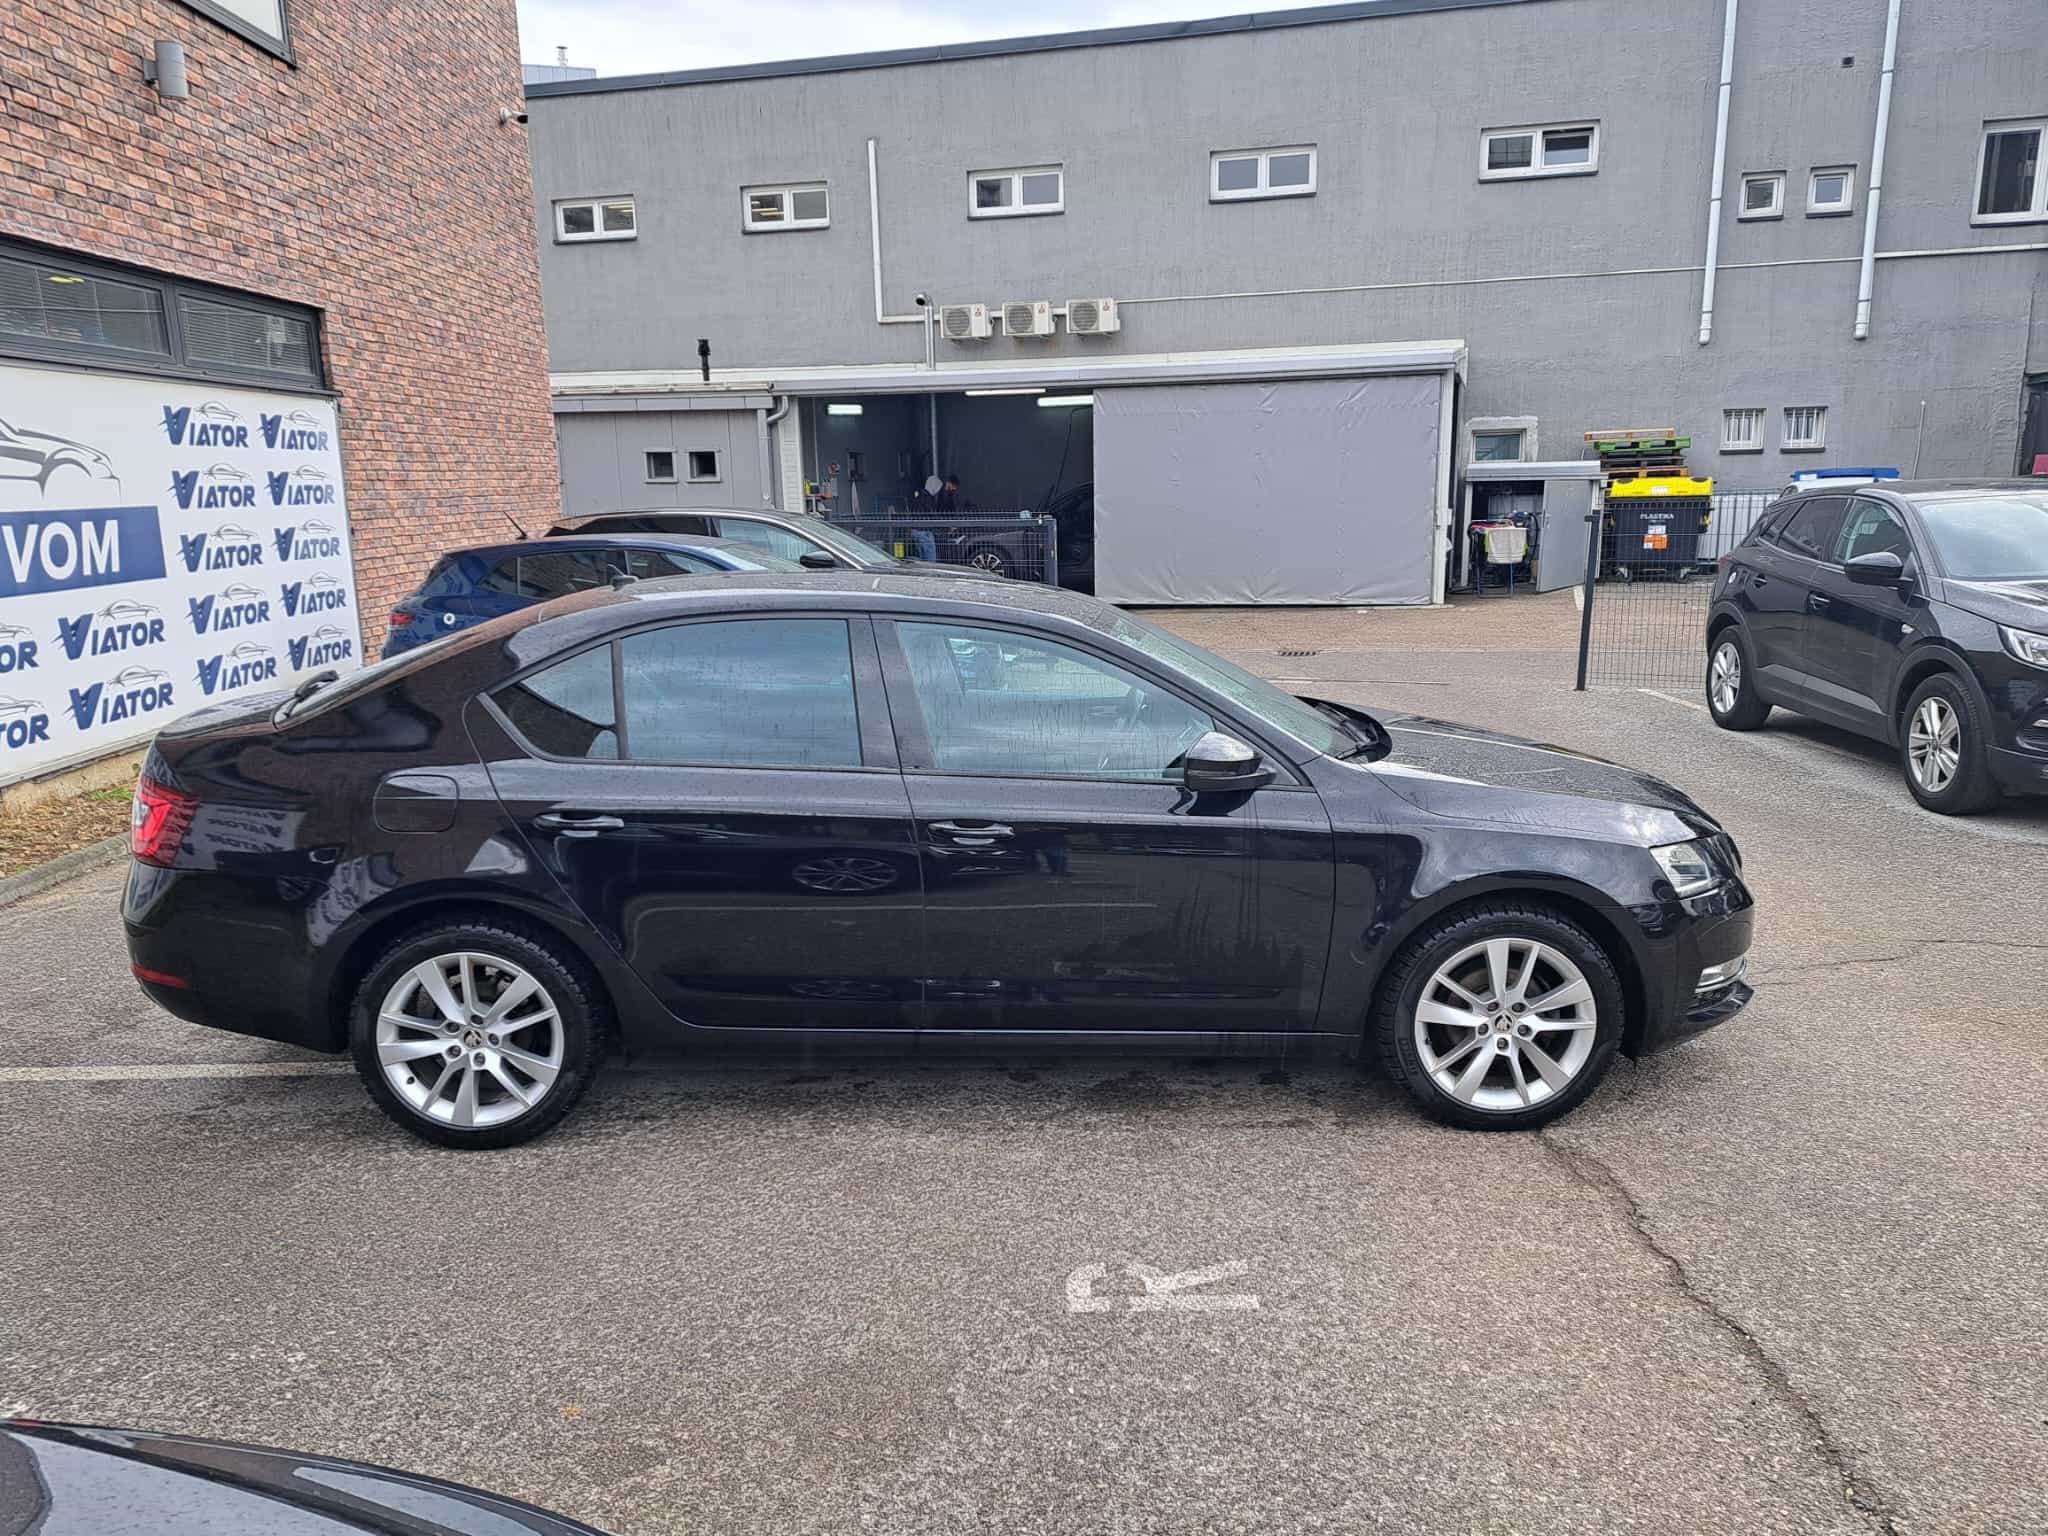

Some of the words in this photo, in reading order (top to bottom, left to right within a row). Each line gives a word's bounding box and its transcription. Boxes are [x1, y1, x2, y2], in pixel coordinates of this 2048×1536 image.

[163, 405, 249, 448] VIATOR
[260, 416, 328, 453] VIATOR
[171, 470, 256, 511] VIATOR
[266, 471, 336, 508] VIATOR
[1, 519, 121, 584] VOM
[180, 533, 262, 575] VIATOR
[274, 528, 342, 561] VIATOR
[188, 595, 271, 636] VIATOR
[279, 582, 348, 618] VIATOR
[55, 614, 165, 661] VIATOR
[287, 639, 352, 671] VIATOR
[195, 655, 277, 696] VIATOR
[69, 682, 172, 731] VIATOR
